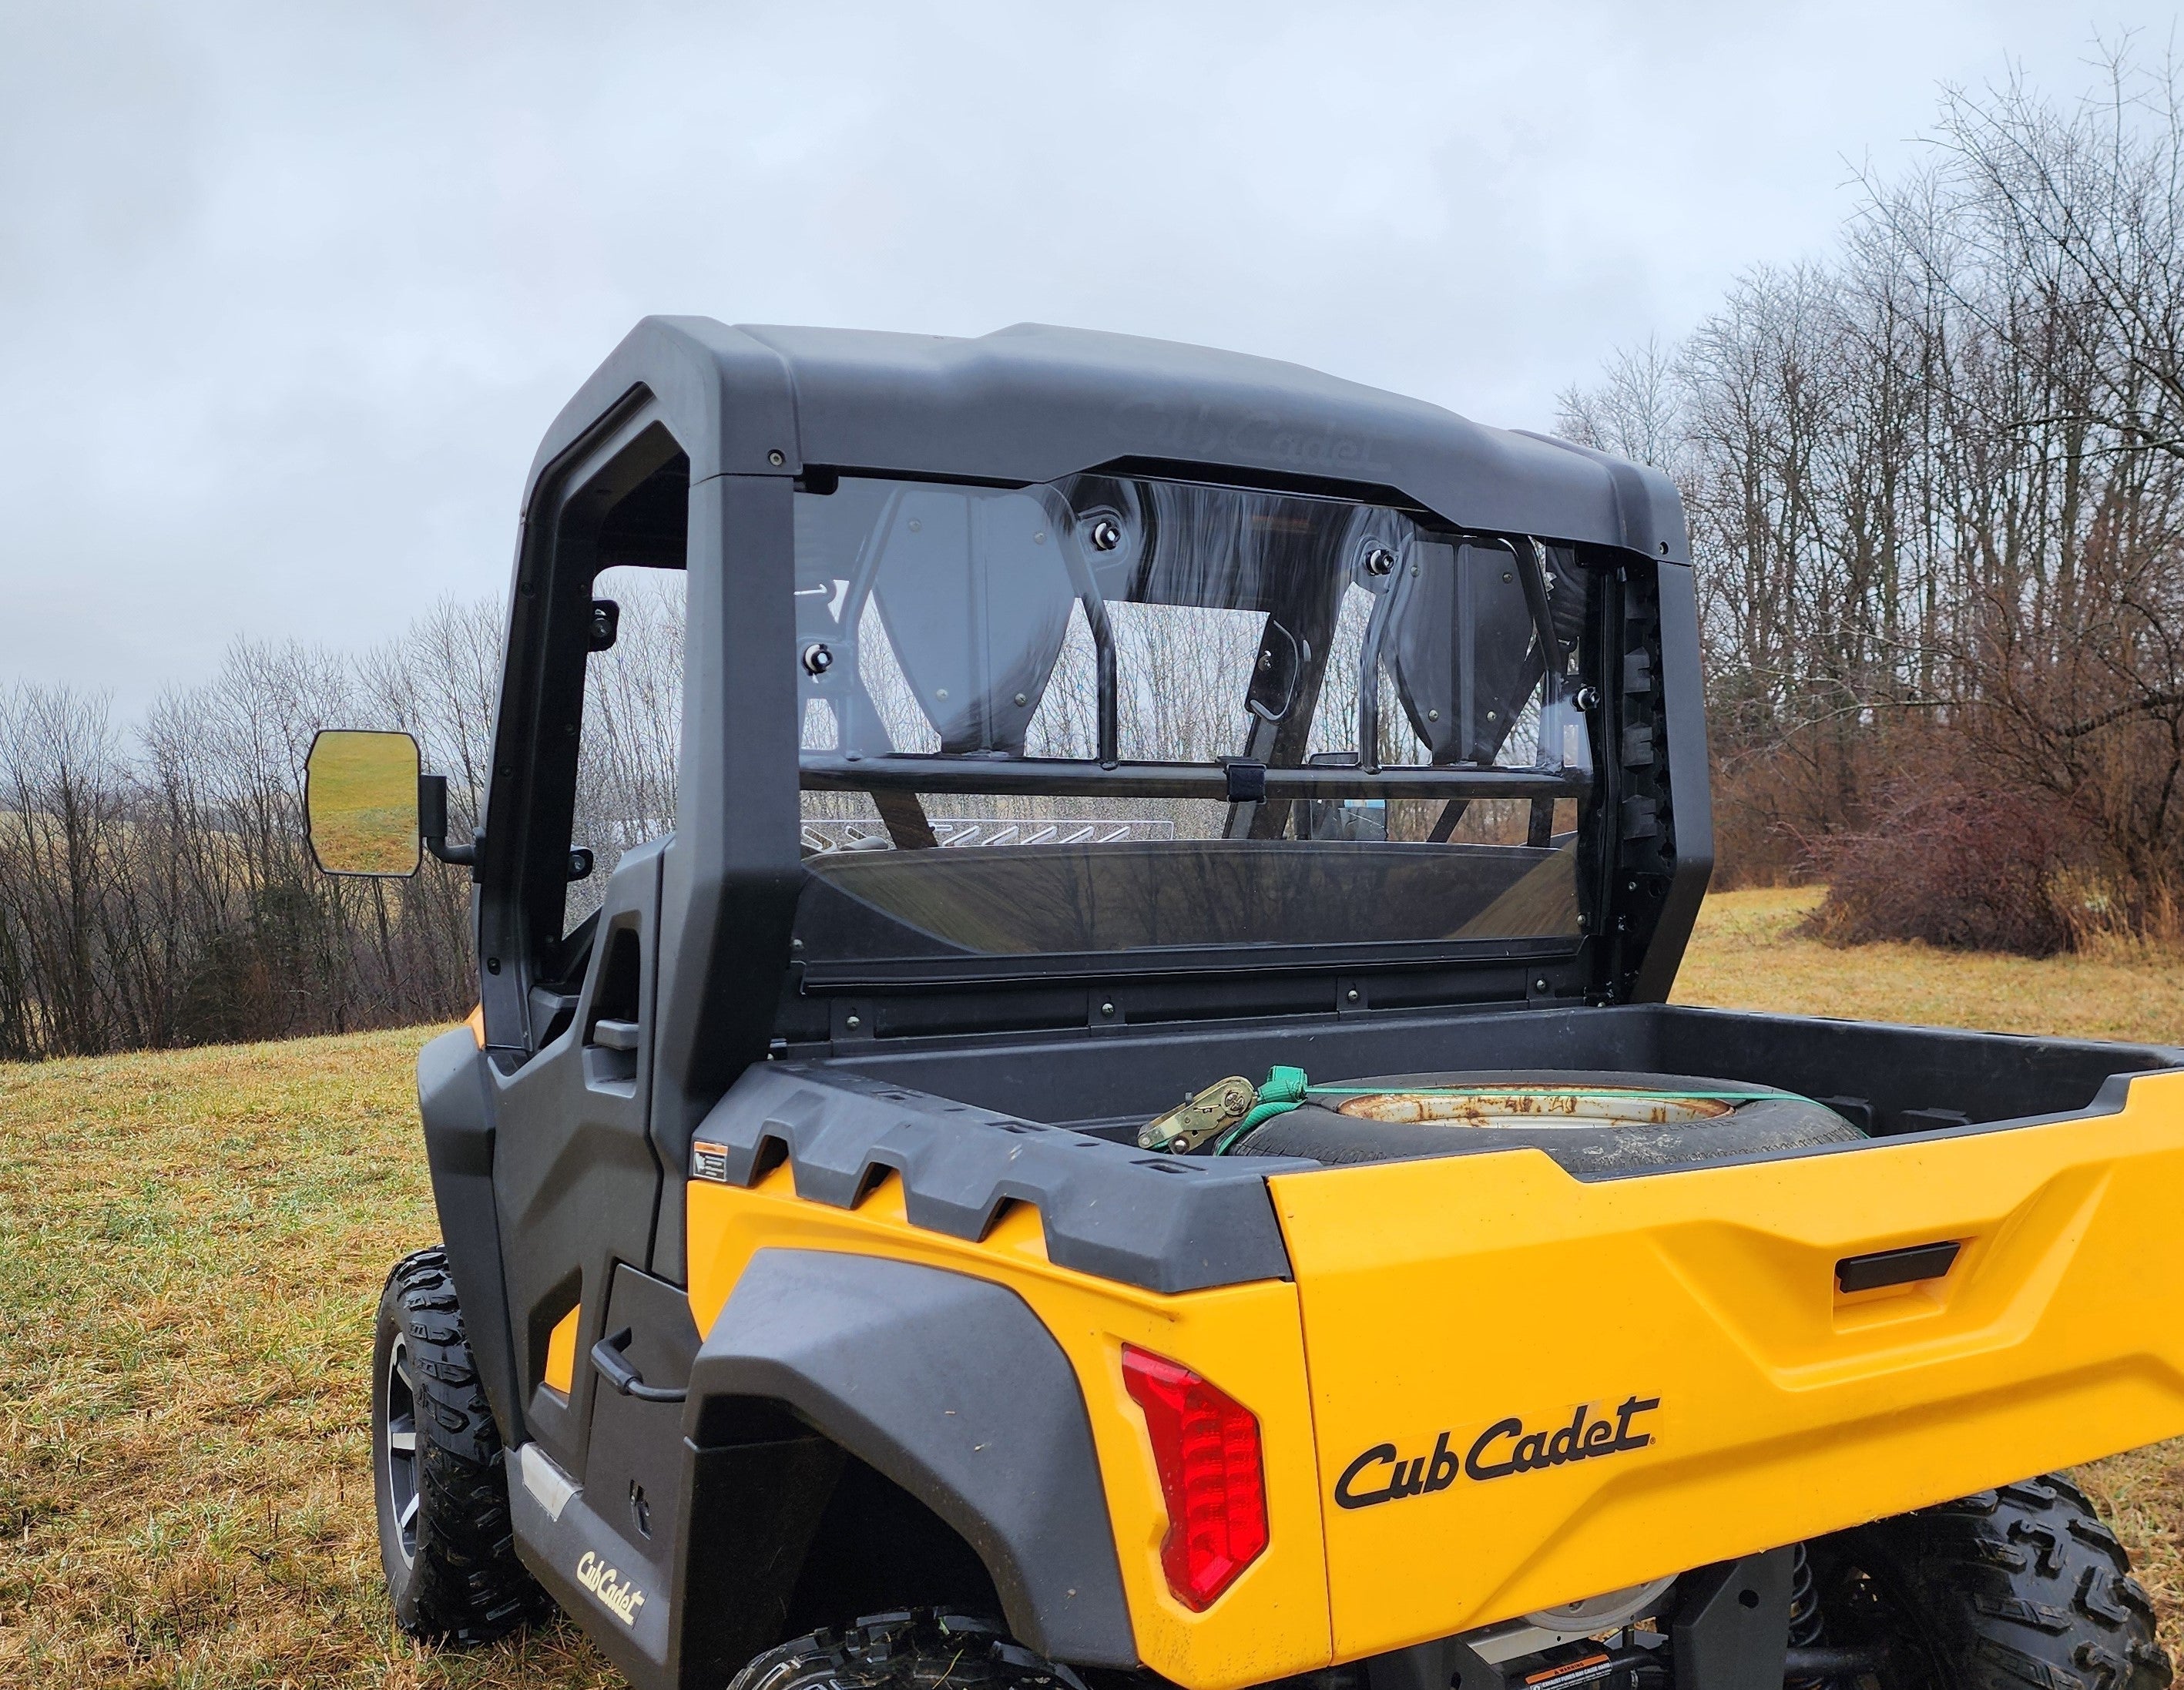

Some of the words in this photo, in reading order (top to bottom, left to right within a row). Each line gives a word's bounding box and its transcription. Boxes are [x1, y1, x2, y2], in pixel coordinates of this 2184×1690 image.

[1335, 1431, 1460, 1510] Cub
[1465, 1395, 1661, 1481] Cadet
[576, 1551, 605, 1592] Cub
[597, 1568, 646, 1626] Cadet
[1559, 1661, 1585, 1673] WARNING
